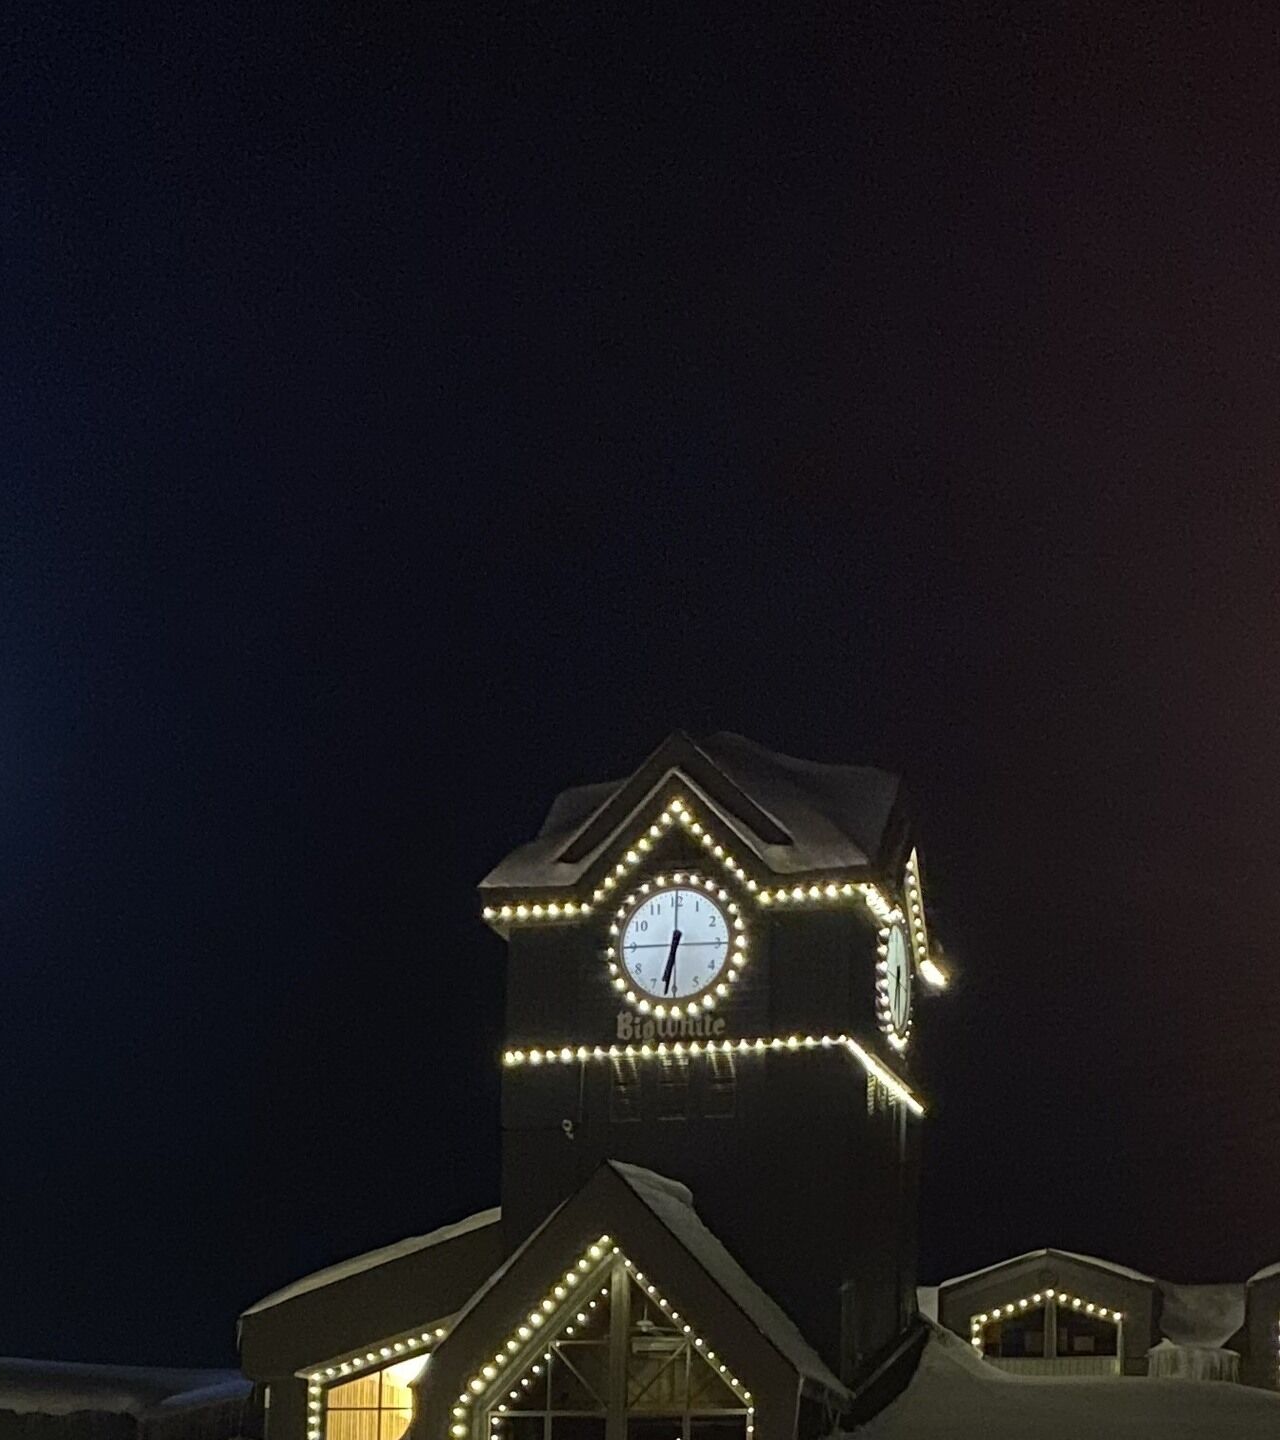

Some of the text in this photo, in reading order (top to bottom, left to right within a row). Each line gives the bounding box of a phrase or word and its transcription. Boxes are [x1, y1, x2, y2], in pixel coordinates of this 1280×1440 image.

[649, 903, 662, 916] 11
[634, 920, 649, 933] 10
[708, 915, 717, 928] 2
[634, 962, 643, 975] 8
[707, 959, 716, 971] 4
